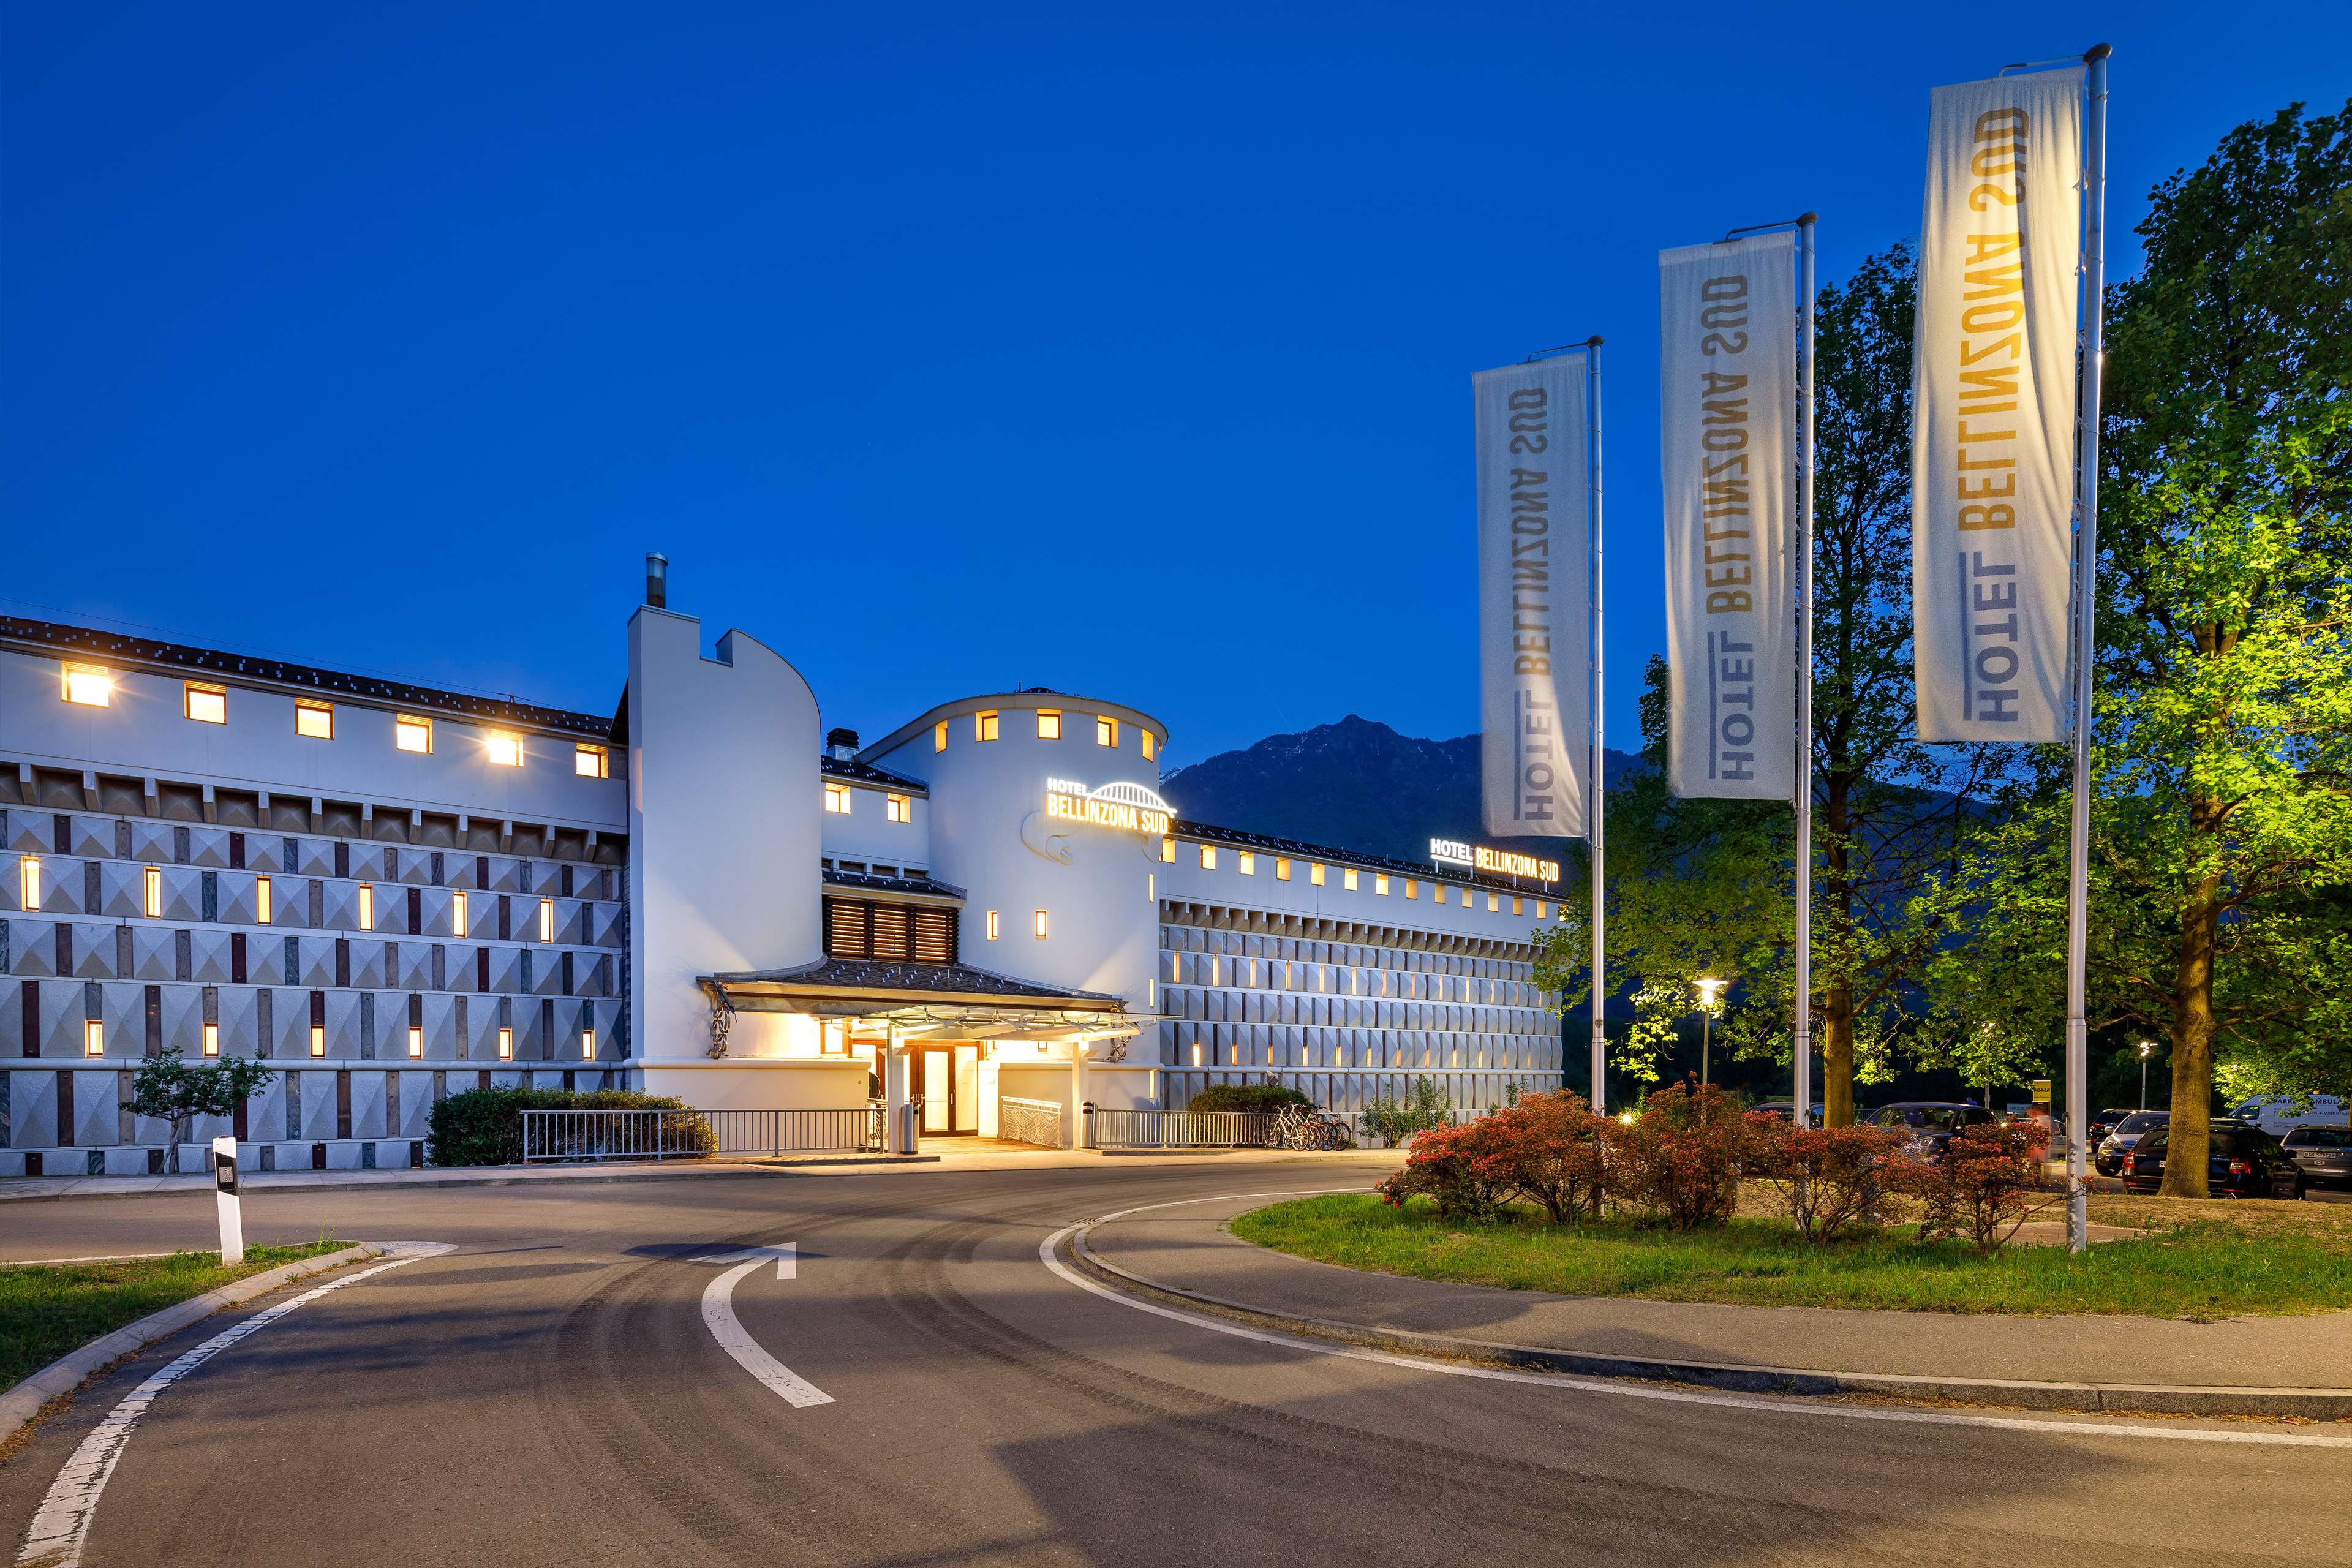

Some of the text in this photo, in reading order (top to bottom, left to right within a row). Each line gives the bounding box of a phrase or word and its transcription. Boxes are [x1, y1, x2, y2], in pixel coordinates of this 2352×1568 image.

[1047, 777, 1088, 796] HOTEL
[1047, 794, 1168, 834] BELLINZONA SUD
[1431, 838, 1559, 882] HOTEL BELLINZONA SUD
